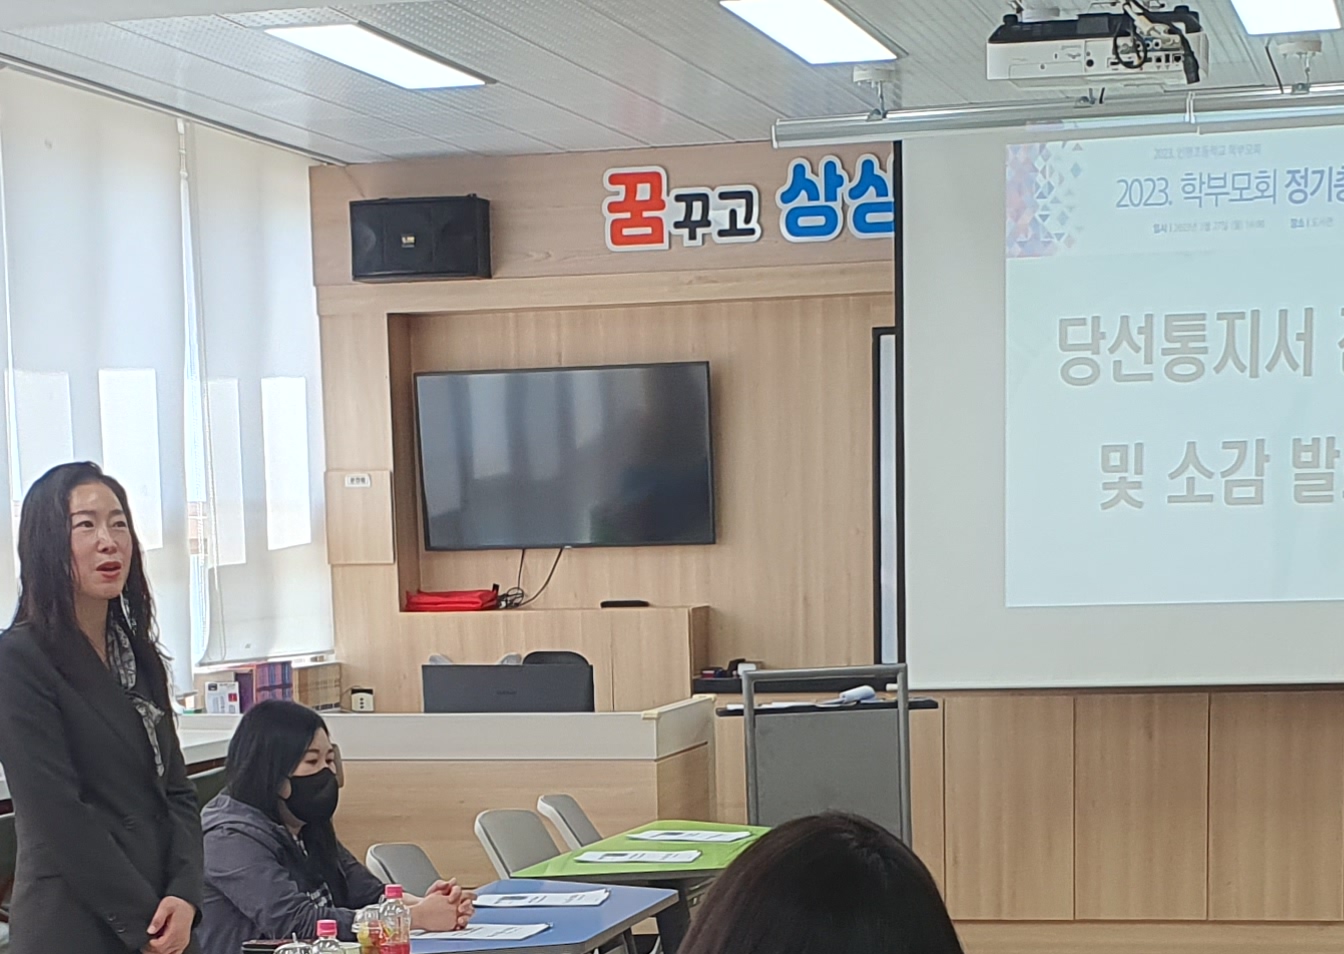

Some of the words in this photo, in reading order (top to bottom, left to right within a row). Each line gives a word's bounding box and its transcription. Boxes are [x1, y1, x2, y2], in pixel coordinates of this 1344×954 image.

[607, 171, 756, 246] 꿈꾸고
[1115, 177, 1173, 208] 2023.
[1180, 168, 1278, 208] 학부모회
[1057, 307, 1313, 387] 당선통지서
[1099, 441, 1145, 511] 및
[1166, 437, 1270, 506] 소감
